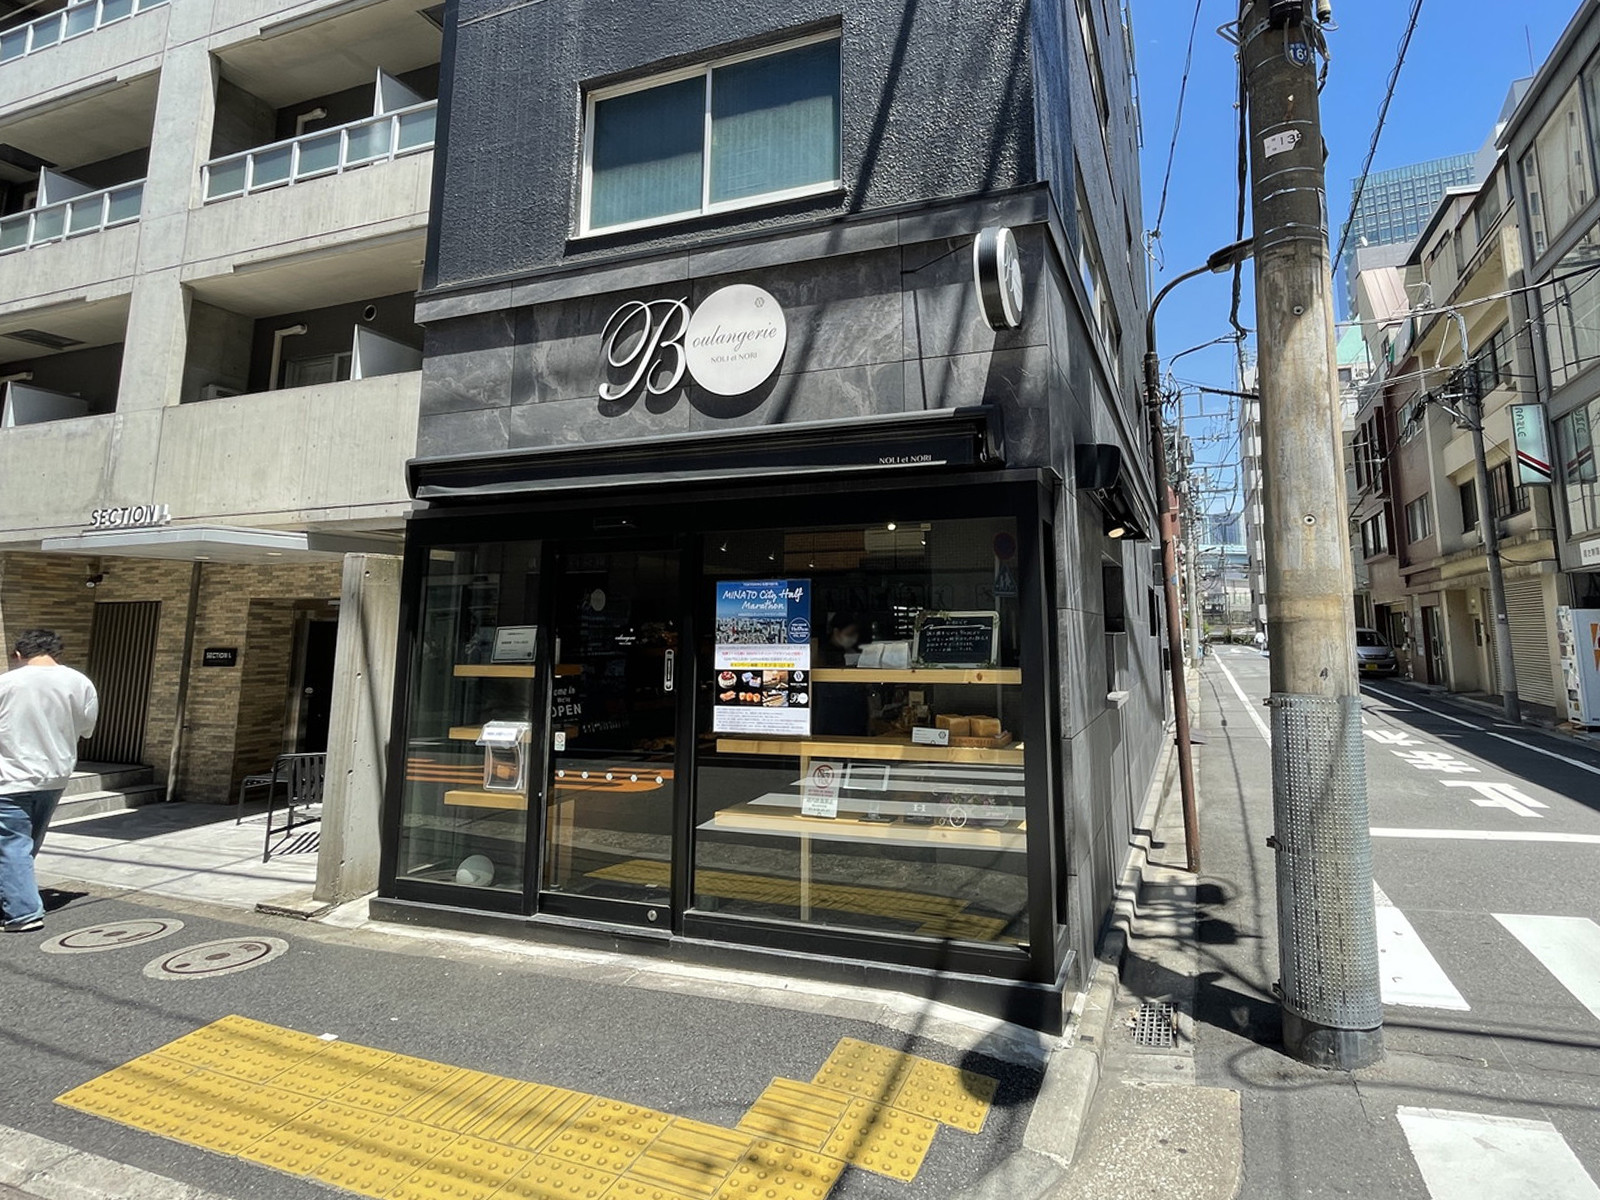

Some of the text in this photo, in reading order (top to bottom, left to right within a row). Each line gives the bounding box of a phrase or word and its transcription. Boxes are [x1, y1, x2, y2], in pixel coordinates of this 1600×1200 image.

[901, 456, 909, 464] et
[90, 505, 156, 525] SECTION
[723, 587, 803, 602] MINATO City Half
[742, 600, 784, 609] Marathon
